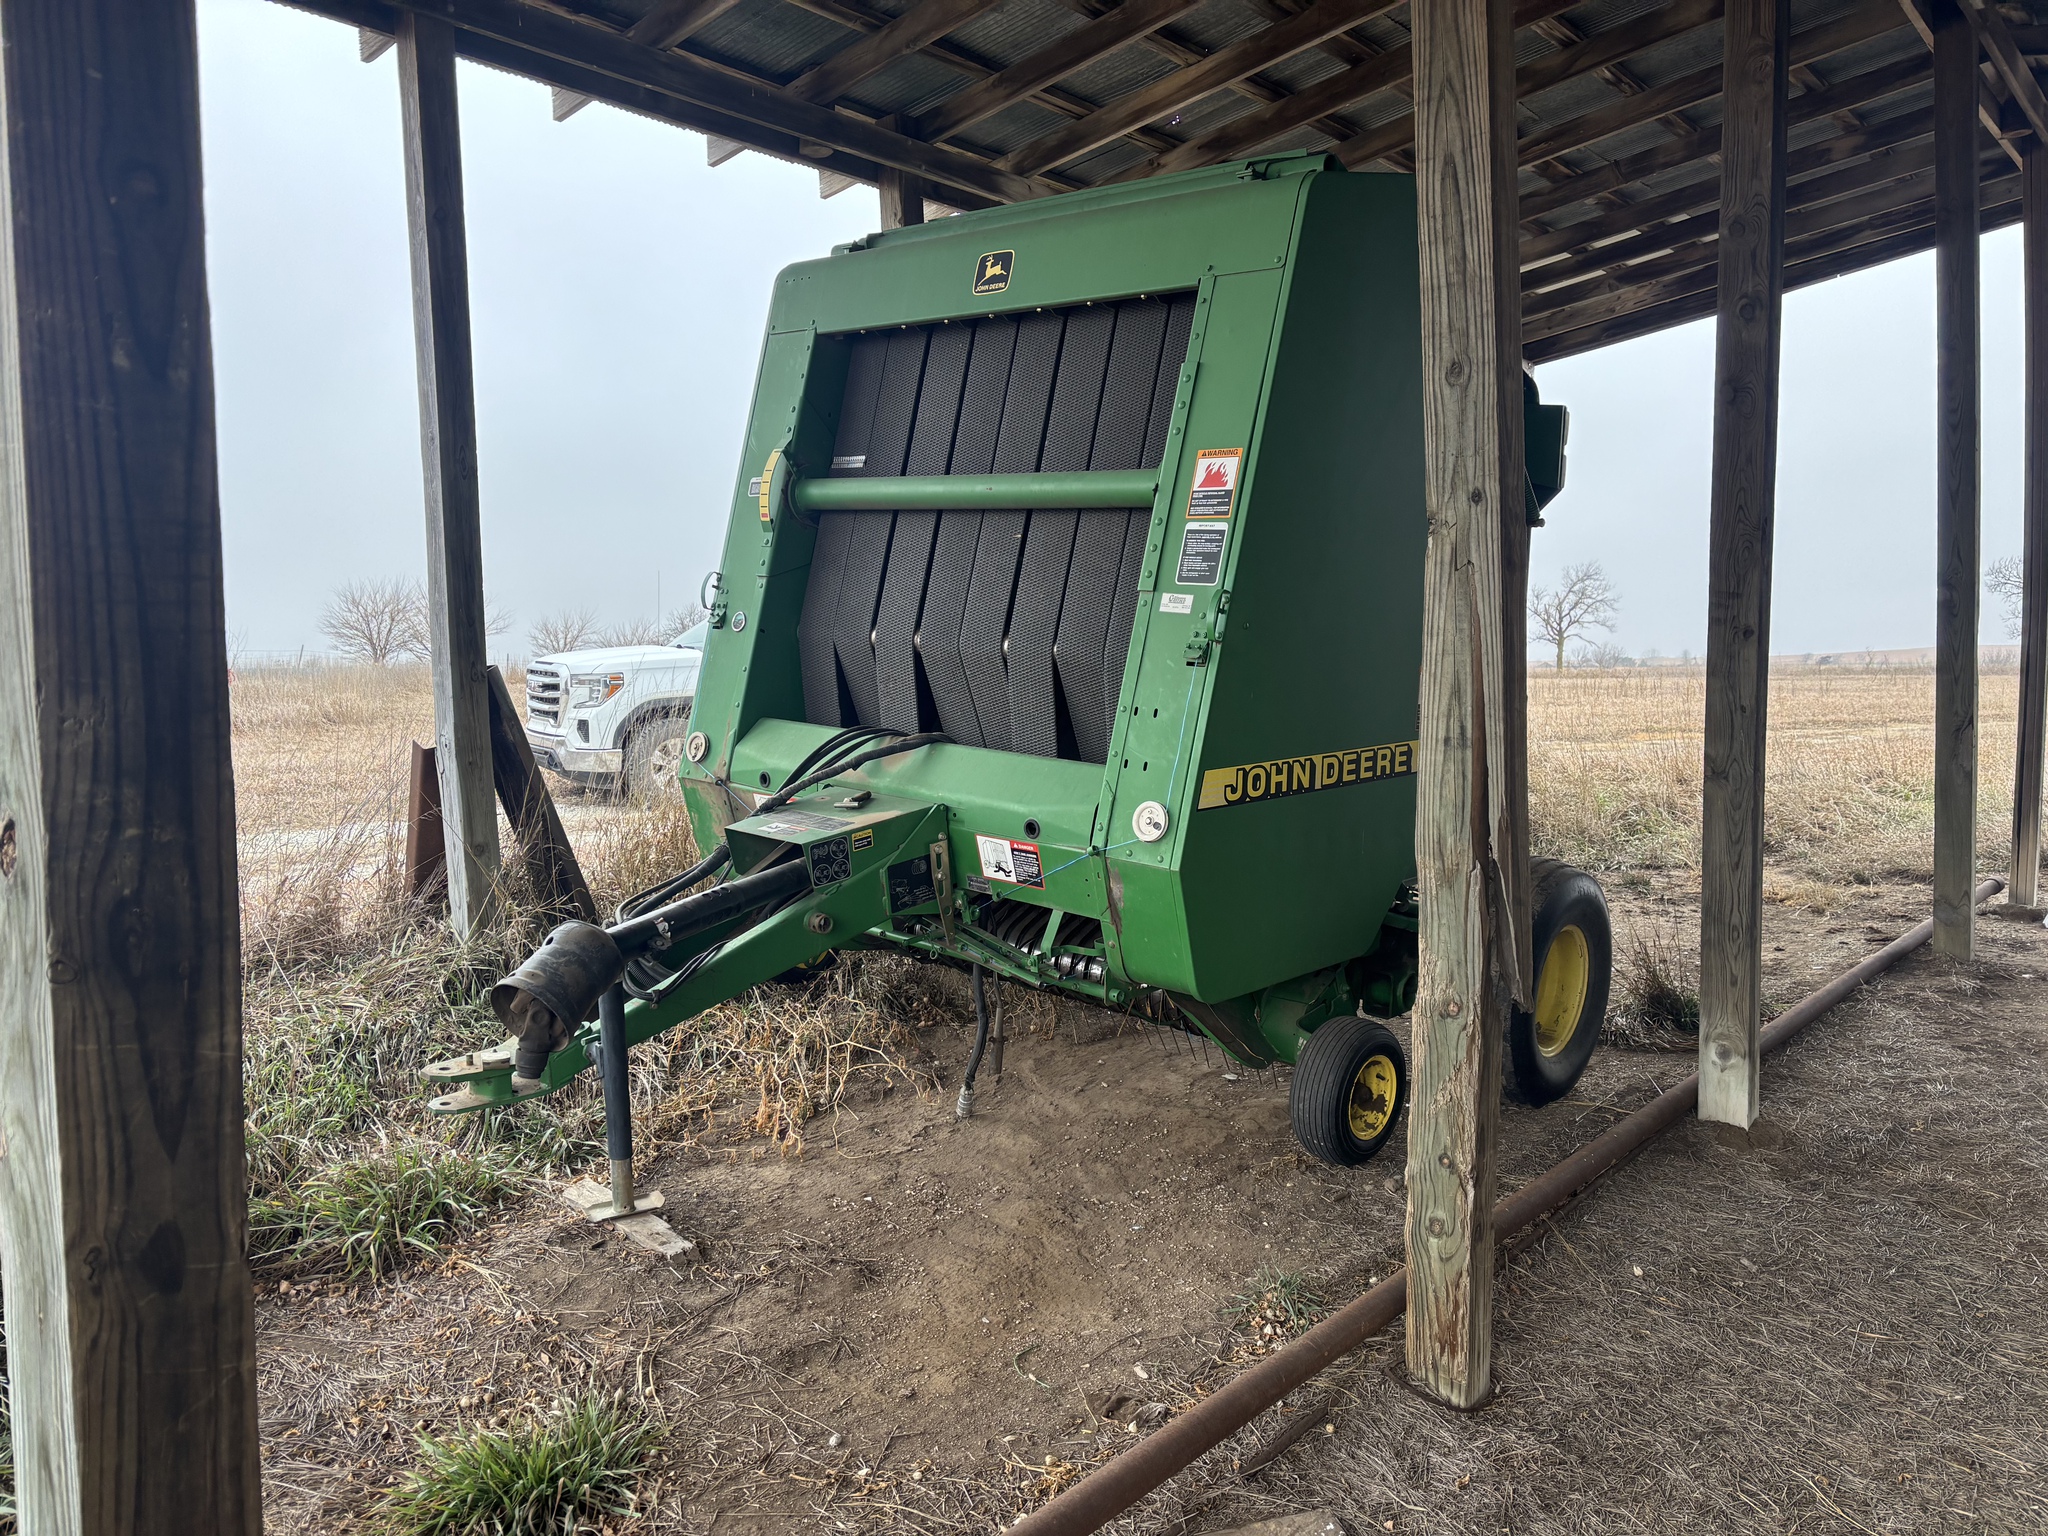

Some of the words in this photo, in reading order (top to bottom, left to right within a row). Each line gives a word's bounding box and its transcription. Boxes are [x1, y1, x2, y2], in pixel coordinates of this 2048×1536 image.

[1207, 448, 1238, 456] WARNING
[1224, 758, 1315, 804] JOHN
[1321, 744, 1411, 787] DEERE
